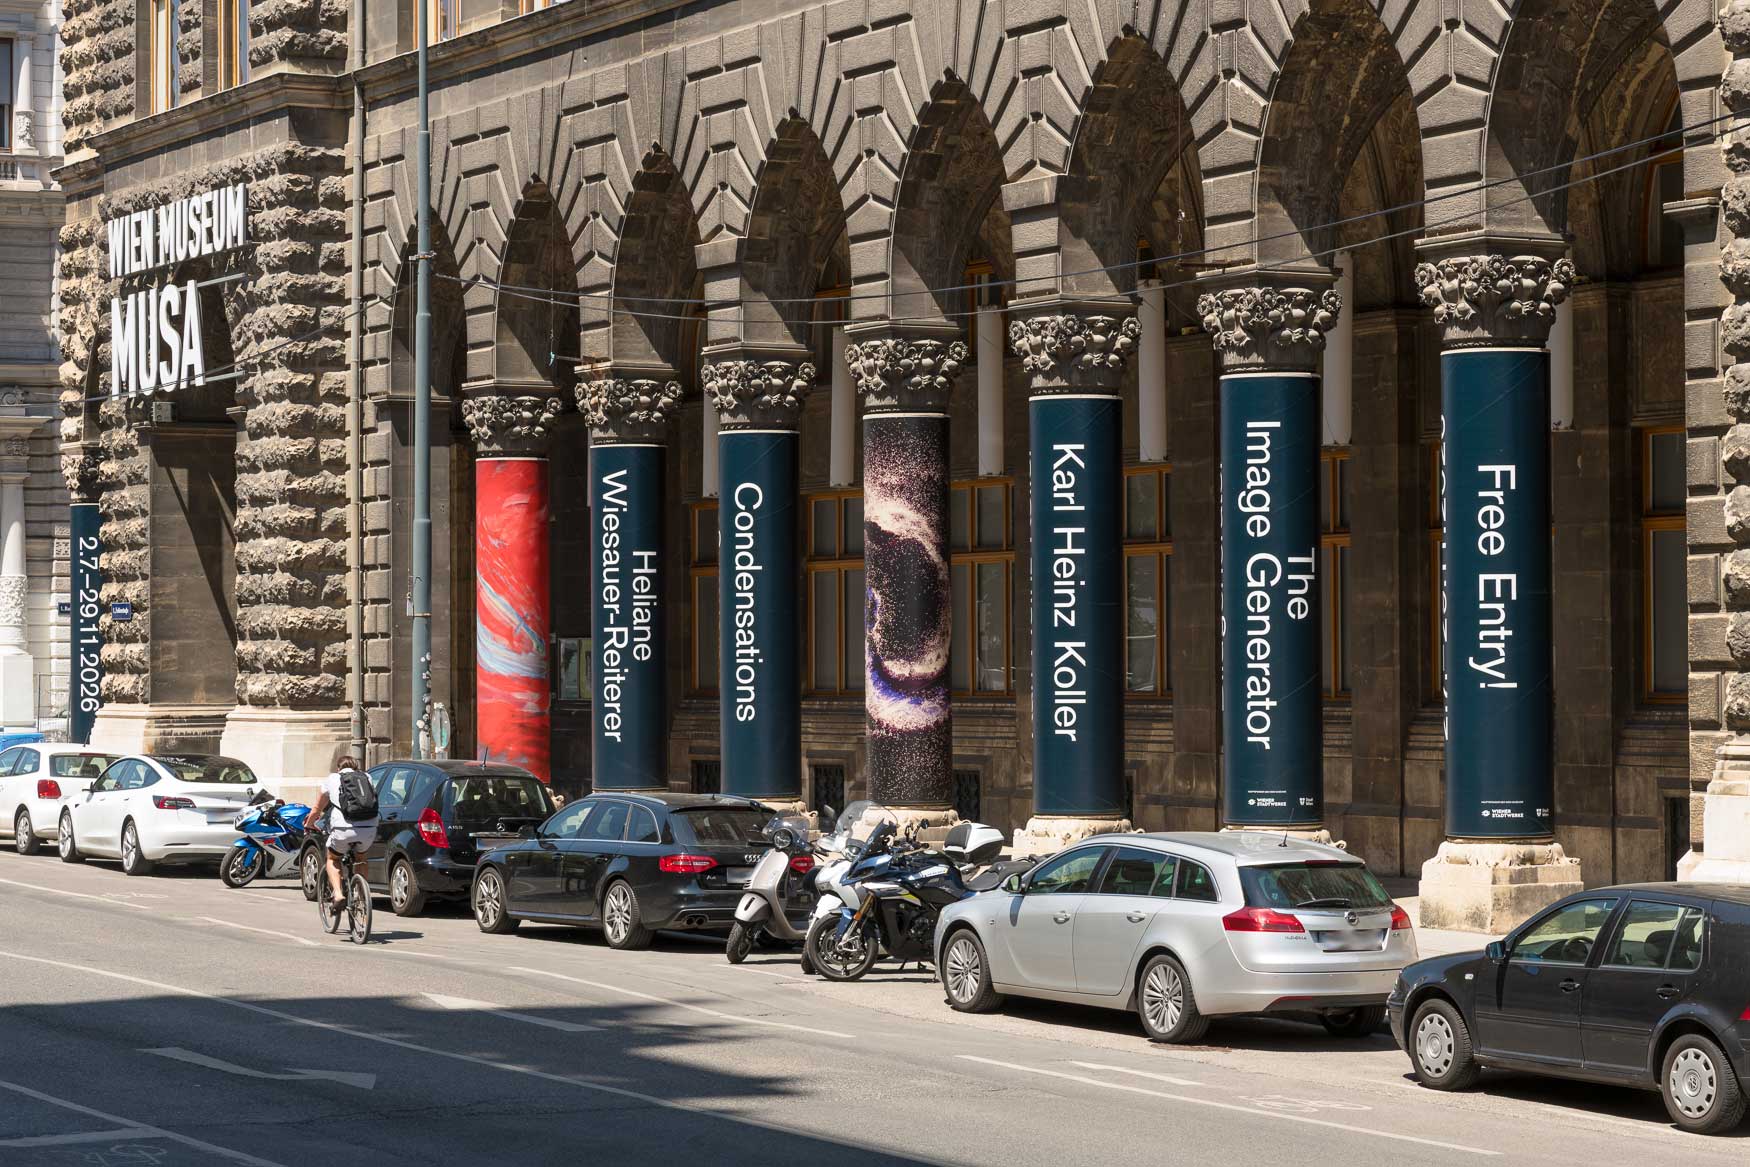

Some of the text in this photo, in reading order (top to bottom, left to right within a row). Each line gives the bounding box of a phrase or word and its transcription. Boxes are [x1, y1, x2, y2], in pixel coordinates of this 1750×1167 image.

[108, 183, 247, 278] WIEN MUSEUM
[111, 280, 206, 401] MUSA
[1237, 421, 1282, 538] Image
[602, 469, 629, 743] Wiesauer-Reiterer
[632, 551, 657, 661] Heliane
[734, 482, 764, 722] Condensations
[1052, 443, 1087, 742] Karl Heinz Koller
[1246, 552, 1282, 750] Generator
[1286, 547, 1316, 620] The
[1468, 464, 1518, 689] Free Entry!
